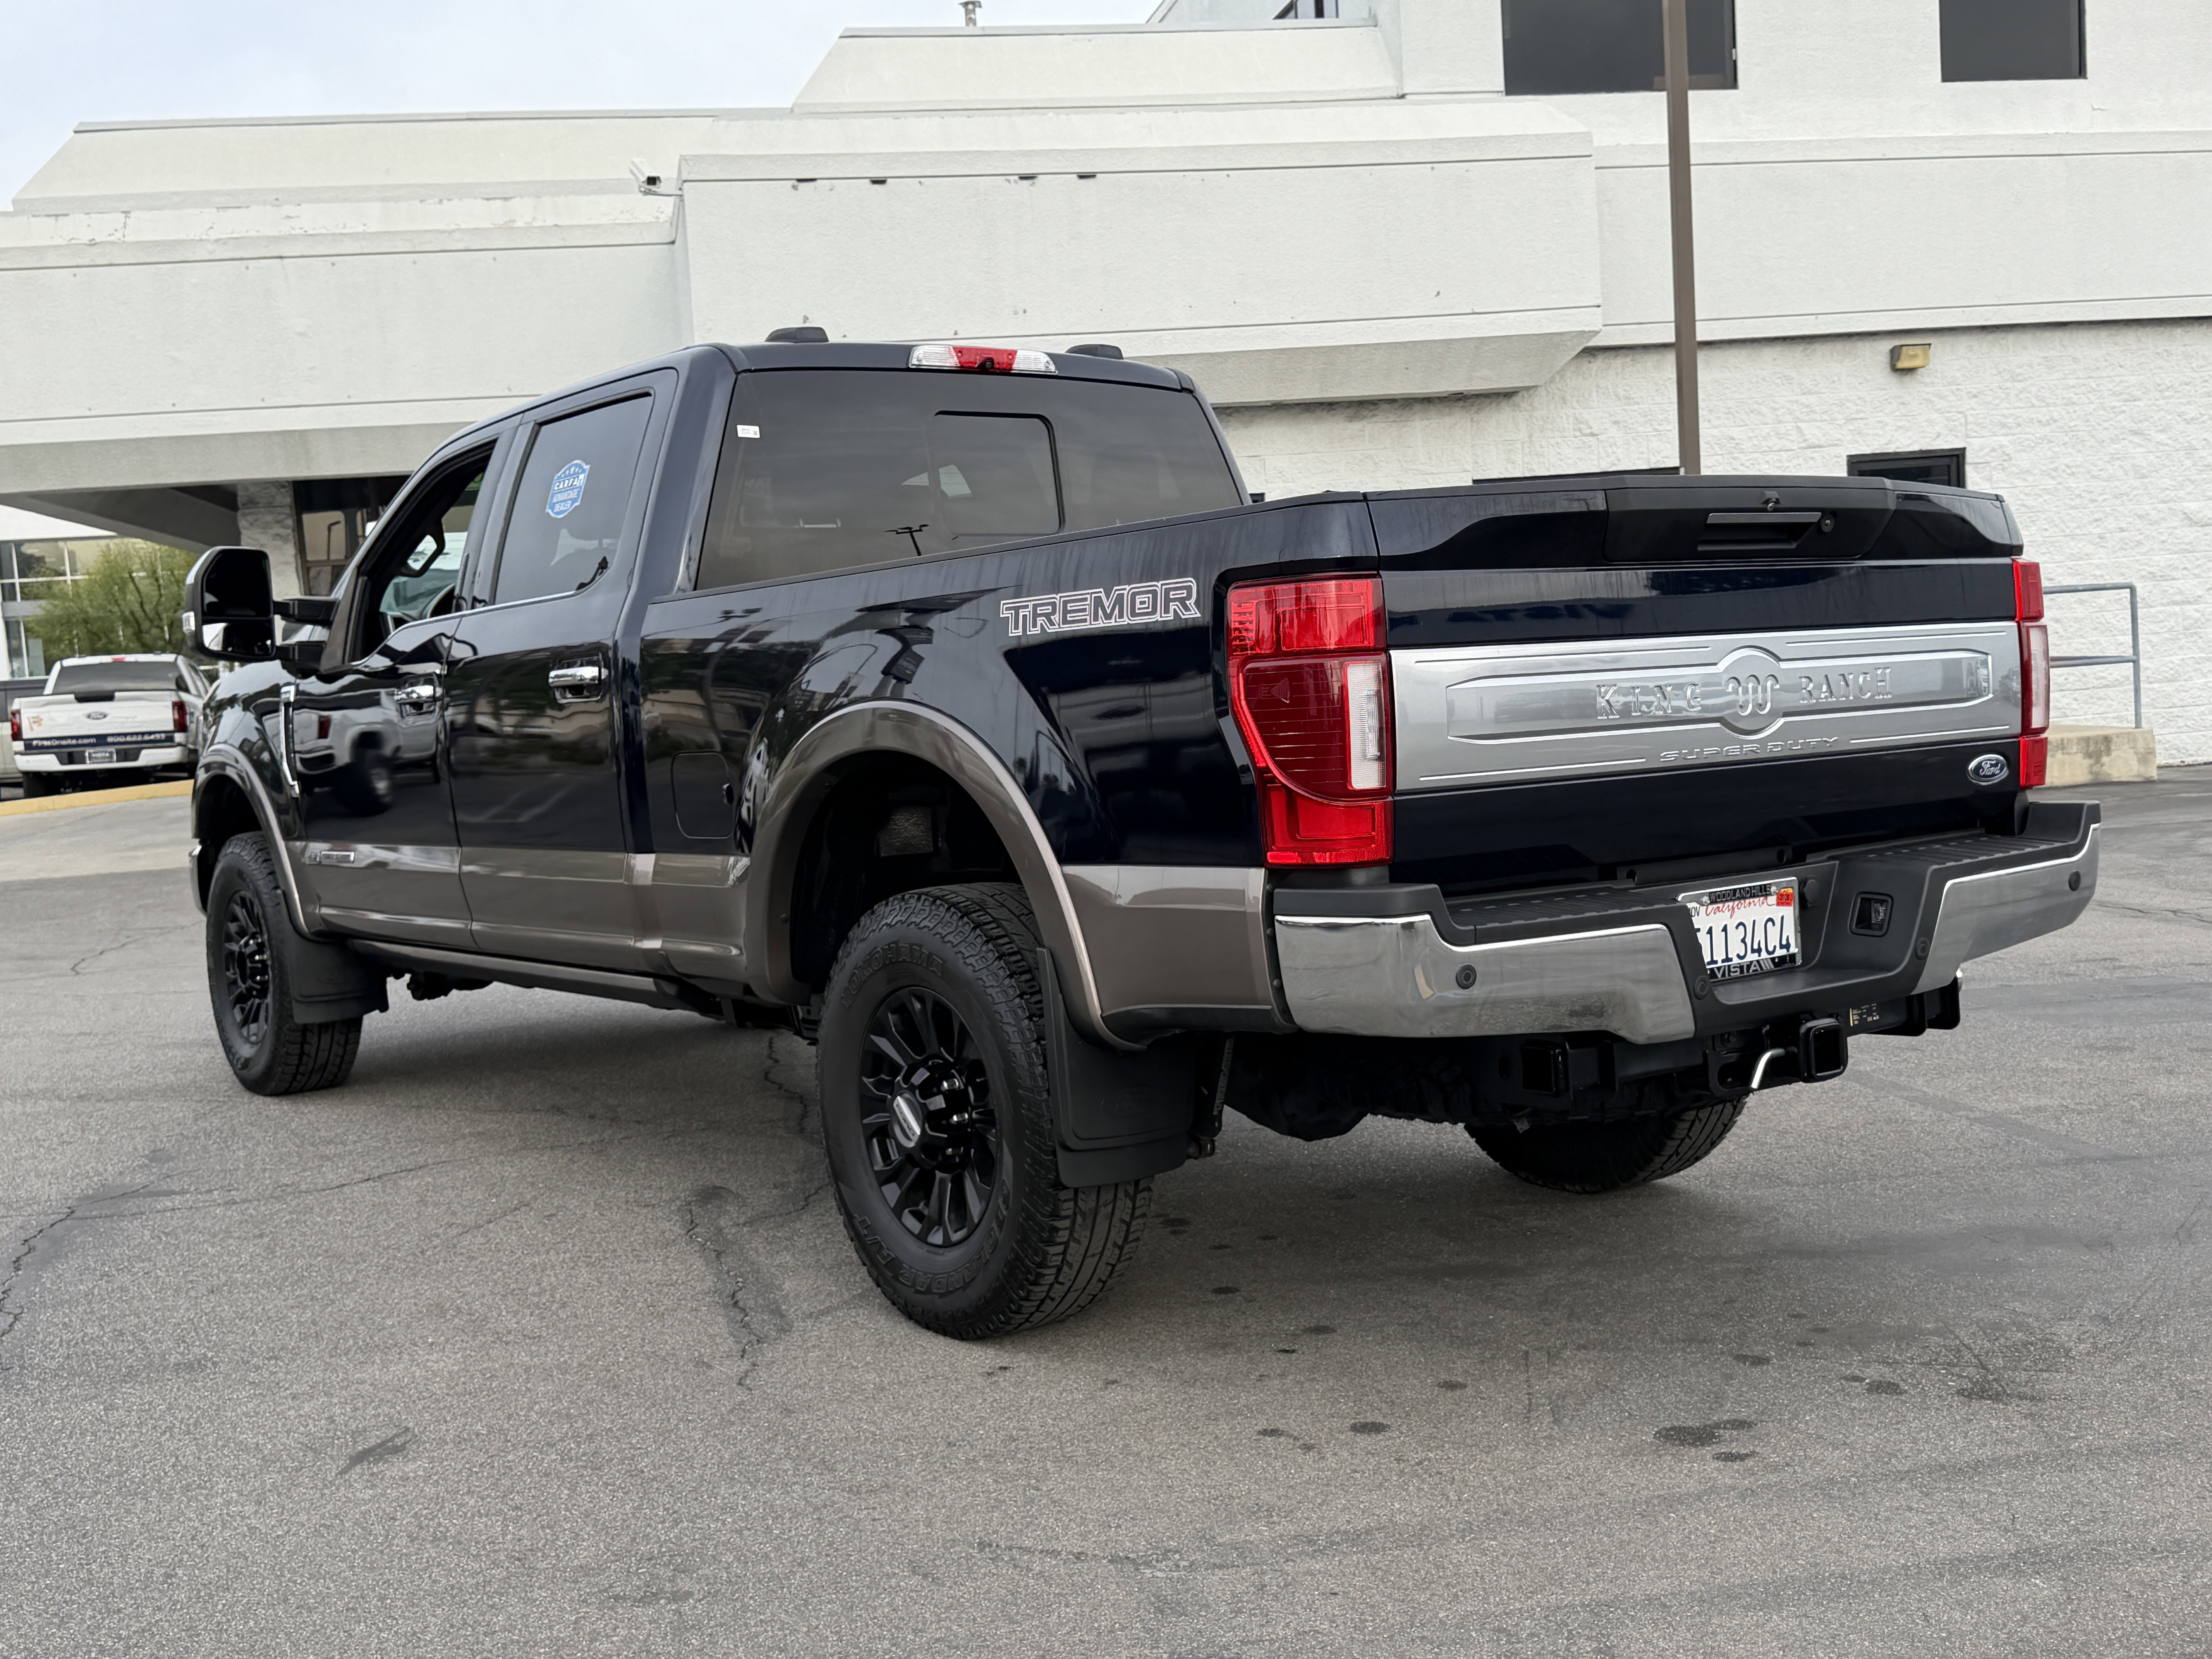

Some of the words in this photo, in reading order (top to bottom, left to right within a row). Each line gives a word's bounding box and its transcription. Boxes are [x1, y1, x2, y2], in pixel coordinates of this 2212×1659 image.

[1000, 578, 1201, 636] TREMOR
[1597, 684, 1702, 720] KING
[1799, 666, 1893, 703] RANCH
[1660, 744, 1760, 762] SUPER
[1767, 737, 1838, 752] DUTY
[1710, 887, 1751, 902] WOODLAND
[1751, 884, 1771, 896] HILLS
[1705, 896, 1776, 919] California
[1695, 915, 1791, 966] 1134C4
[1714, 960, 1761, 979] VISTA
